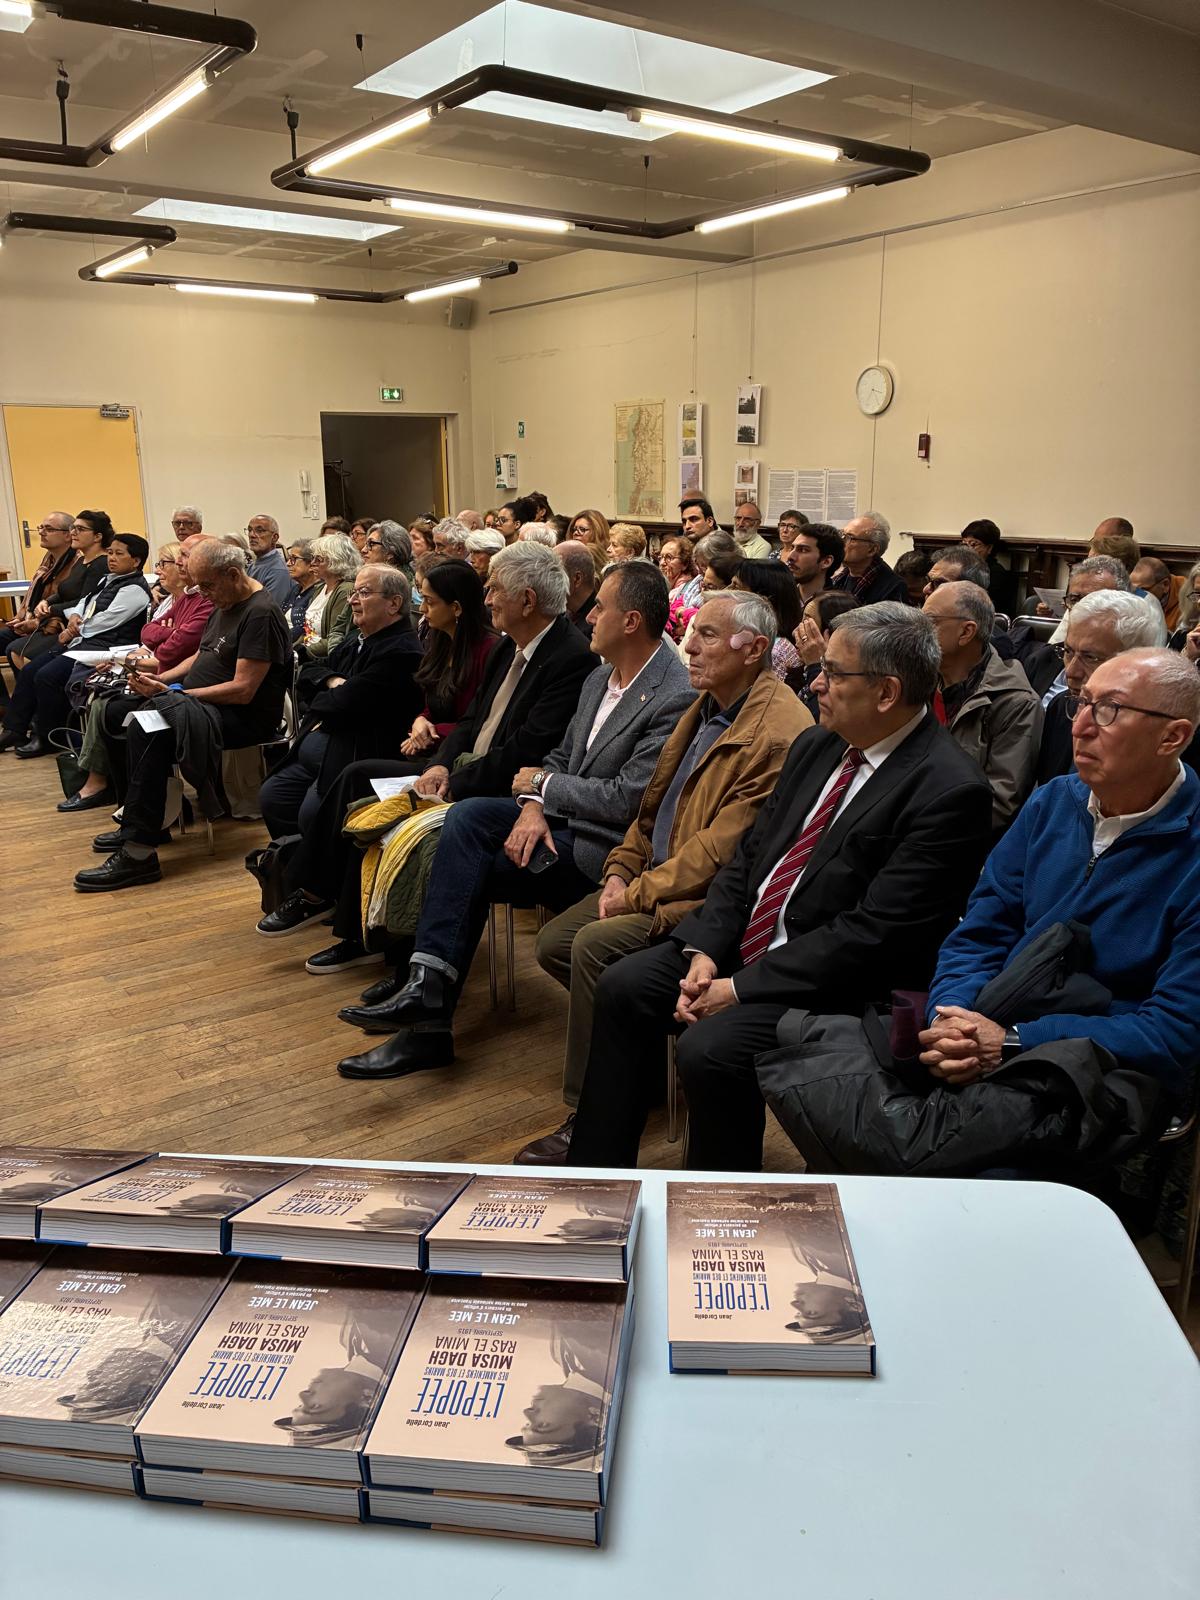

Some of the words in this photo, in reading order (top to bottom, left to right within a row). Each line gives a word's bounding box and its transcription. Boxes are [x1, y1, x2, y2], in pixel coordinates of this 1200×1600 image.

[695, 1229, 716, 1238] MÉE
[719, 1229, 730, 1237] LE
[733, 1229, 757, 1238] JEAN
[692, 1249, 720, 1259] MINA
[725, 1250, 738, 1260] EL
[742, 1250, 763, 1260] RAS
[692, 1261, 725, 1272] DAGH
[729, 1262, 765, 1272] MUSA
[693, 1272, 710, 1280] MARINS
[56, 1281, 82, 1292] MÉE
[81, 1282, 97, 1292] LE
[96, 1283, 126, 1294] JEAN
[247, 1296, 273, 1308] MÉE
[694, 1282, 769, 1312] L'ÉPOPÉE
[273, 1298, 288, 1309] LE
[288, 1300, 318, 1311] JEAN
[69, 1306, 85, 1319] EL
[86, 1307, 111, 1320] RAS
[448, 1311, 473, 1323] MÉE
[474, 1313, 489, 1322] LE
[491, 1313, 520, 1325] JEAN
[228, 1321, 264, 1335] MINA
[266, 1324, 281, 1336] EL
[282, 1324, 309, 1338] RAS
[218, 1335, 258, 1350] DAGH
[260, 1338, 302, 1353] MUSA
[435, 1336, 469, 1350] MINA
[474, 1339, 488, 1351] EL
[490, 1340, 517, 1353] RAS
[211, 1350, 234, 1360] MARINS
[232, 1352, 245, 1361] DES
[243, 1352, 252, 1362] ET
[282, 1355, 294, 1364] DES
[428, 1351, 467, 1366] DAGH
[472, 1353, 513, 1369] MUSA
[424, 1367, 446, 1376] MARINS
[446, 1368, 457, 1377] DES
[457, 1369, 465, 1378] ET
[498, 1372, 509, 1381] DES
[189, 1362, 288, 1402] L'ÉPOPÉE
[411, 1378, 505, 1420] L'ÉPOPÉE
[181, 1401, 208, 1409] Cordelle
[406, 1419, 433, 1427] Cordelle
